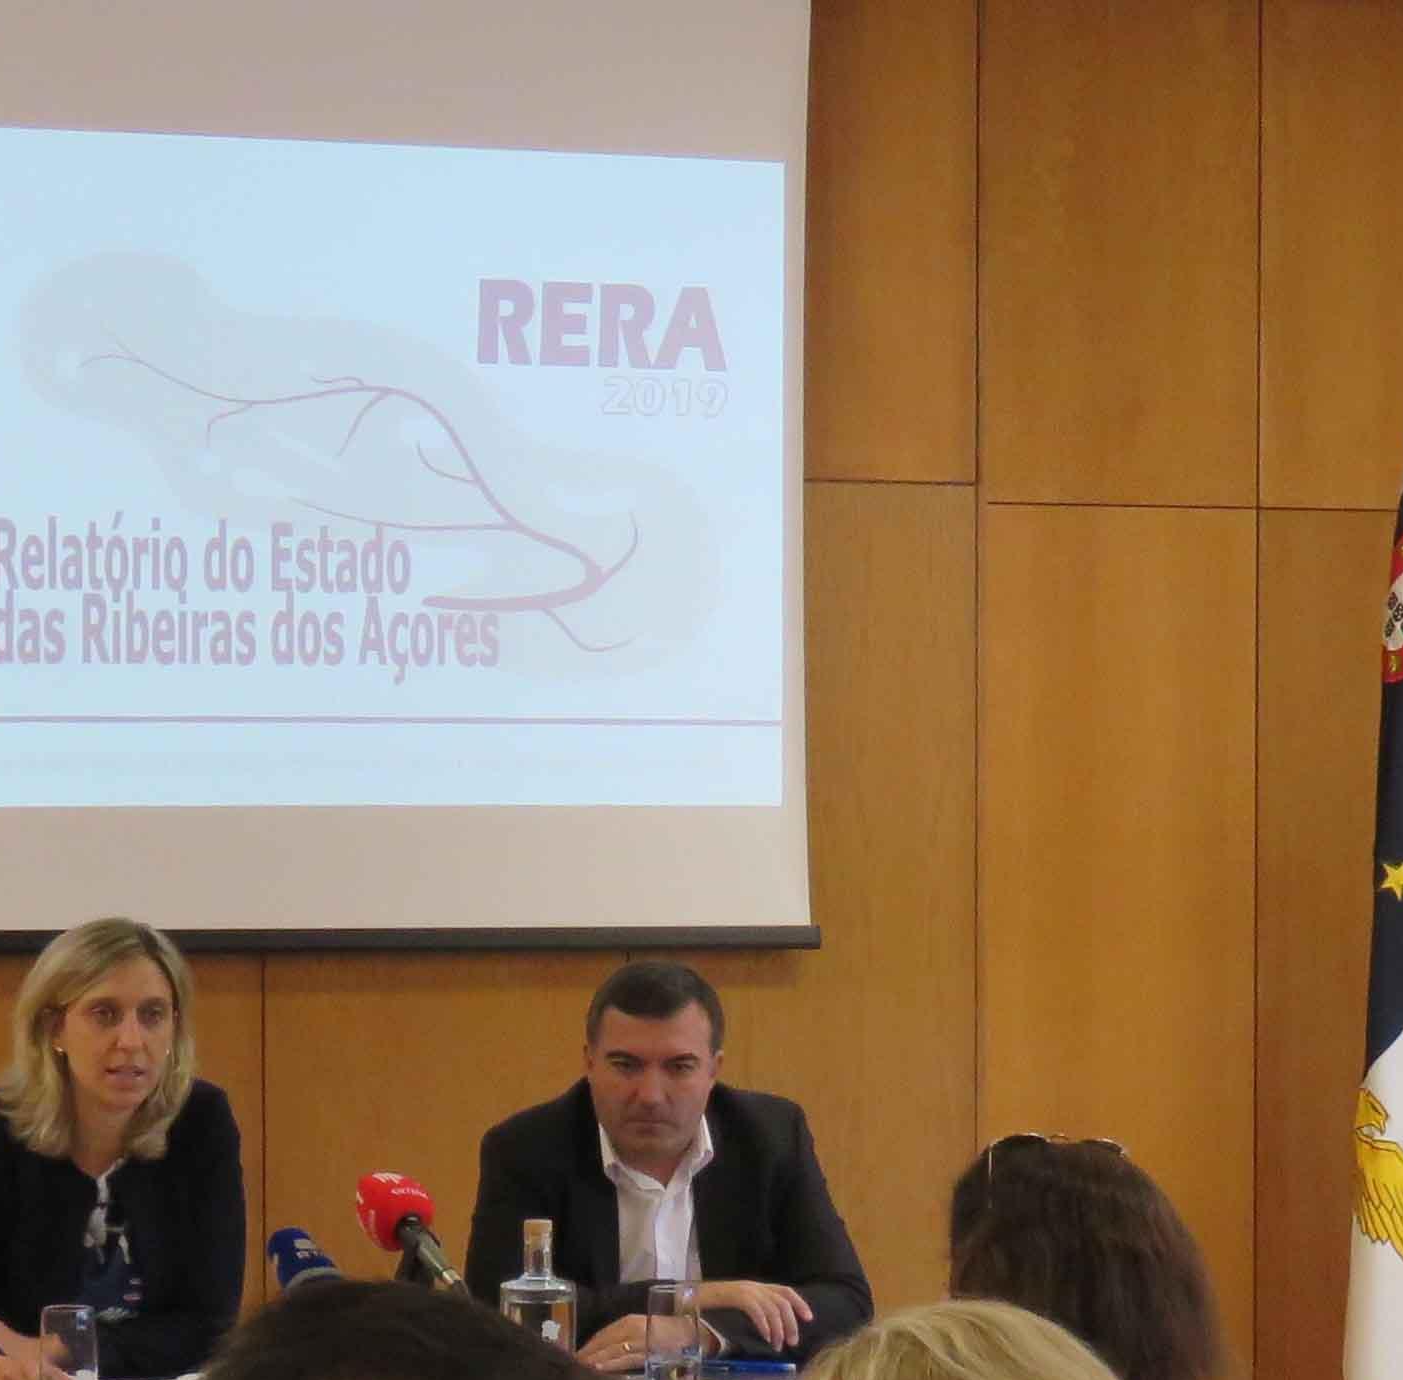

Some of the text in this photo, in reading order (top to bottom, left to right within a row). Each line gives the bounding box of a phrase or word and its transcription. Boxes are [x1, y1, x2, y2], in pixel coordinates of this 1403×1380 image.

[477, 278, 727, 372] RERA
[601, 375, 730, 418] 2019
[203, 520, 255, 593] do
[270, 524, 411, 595] Estado
[82, 590, 257, 666] Ribeiras
[270, 592, 345, 666] dos
[359, 596, 500, 685] Açores
